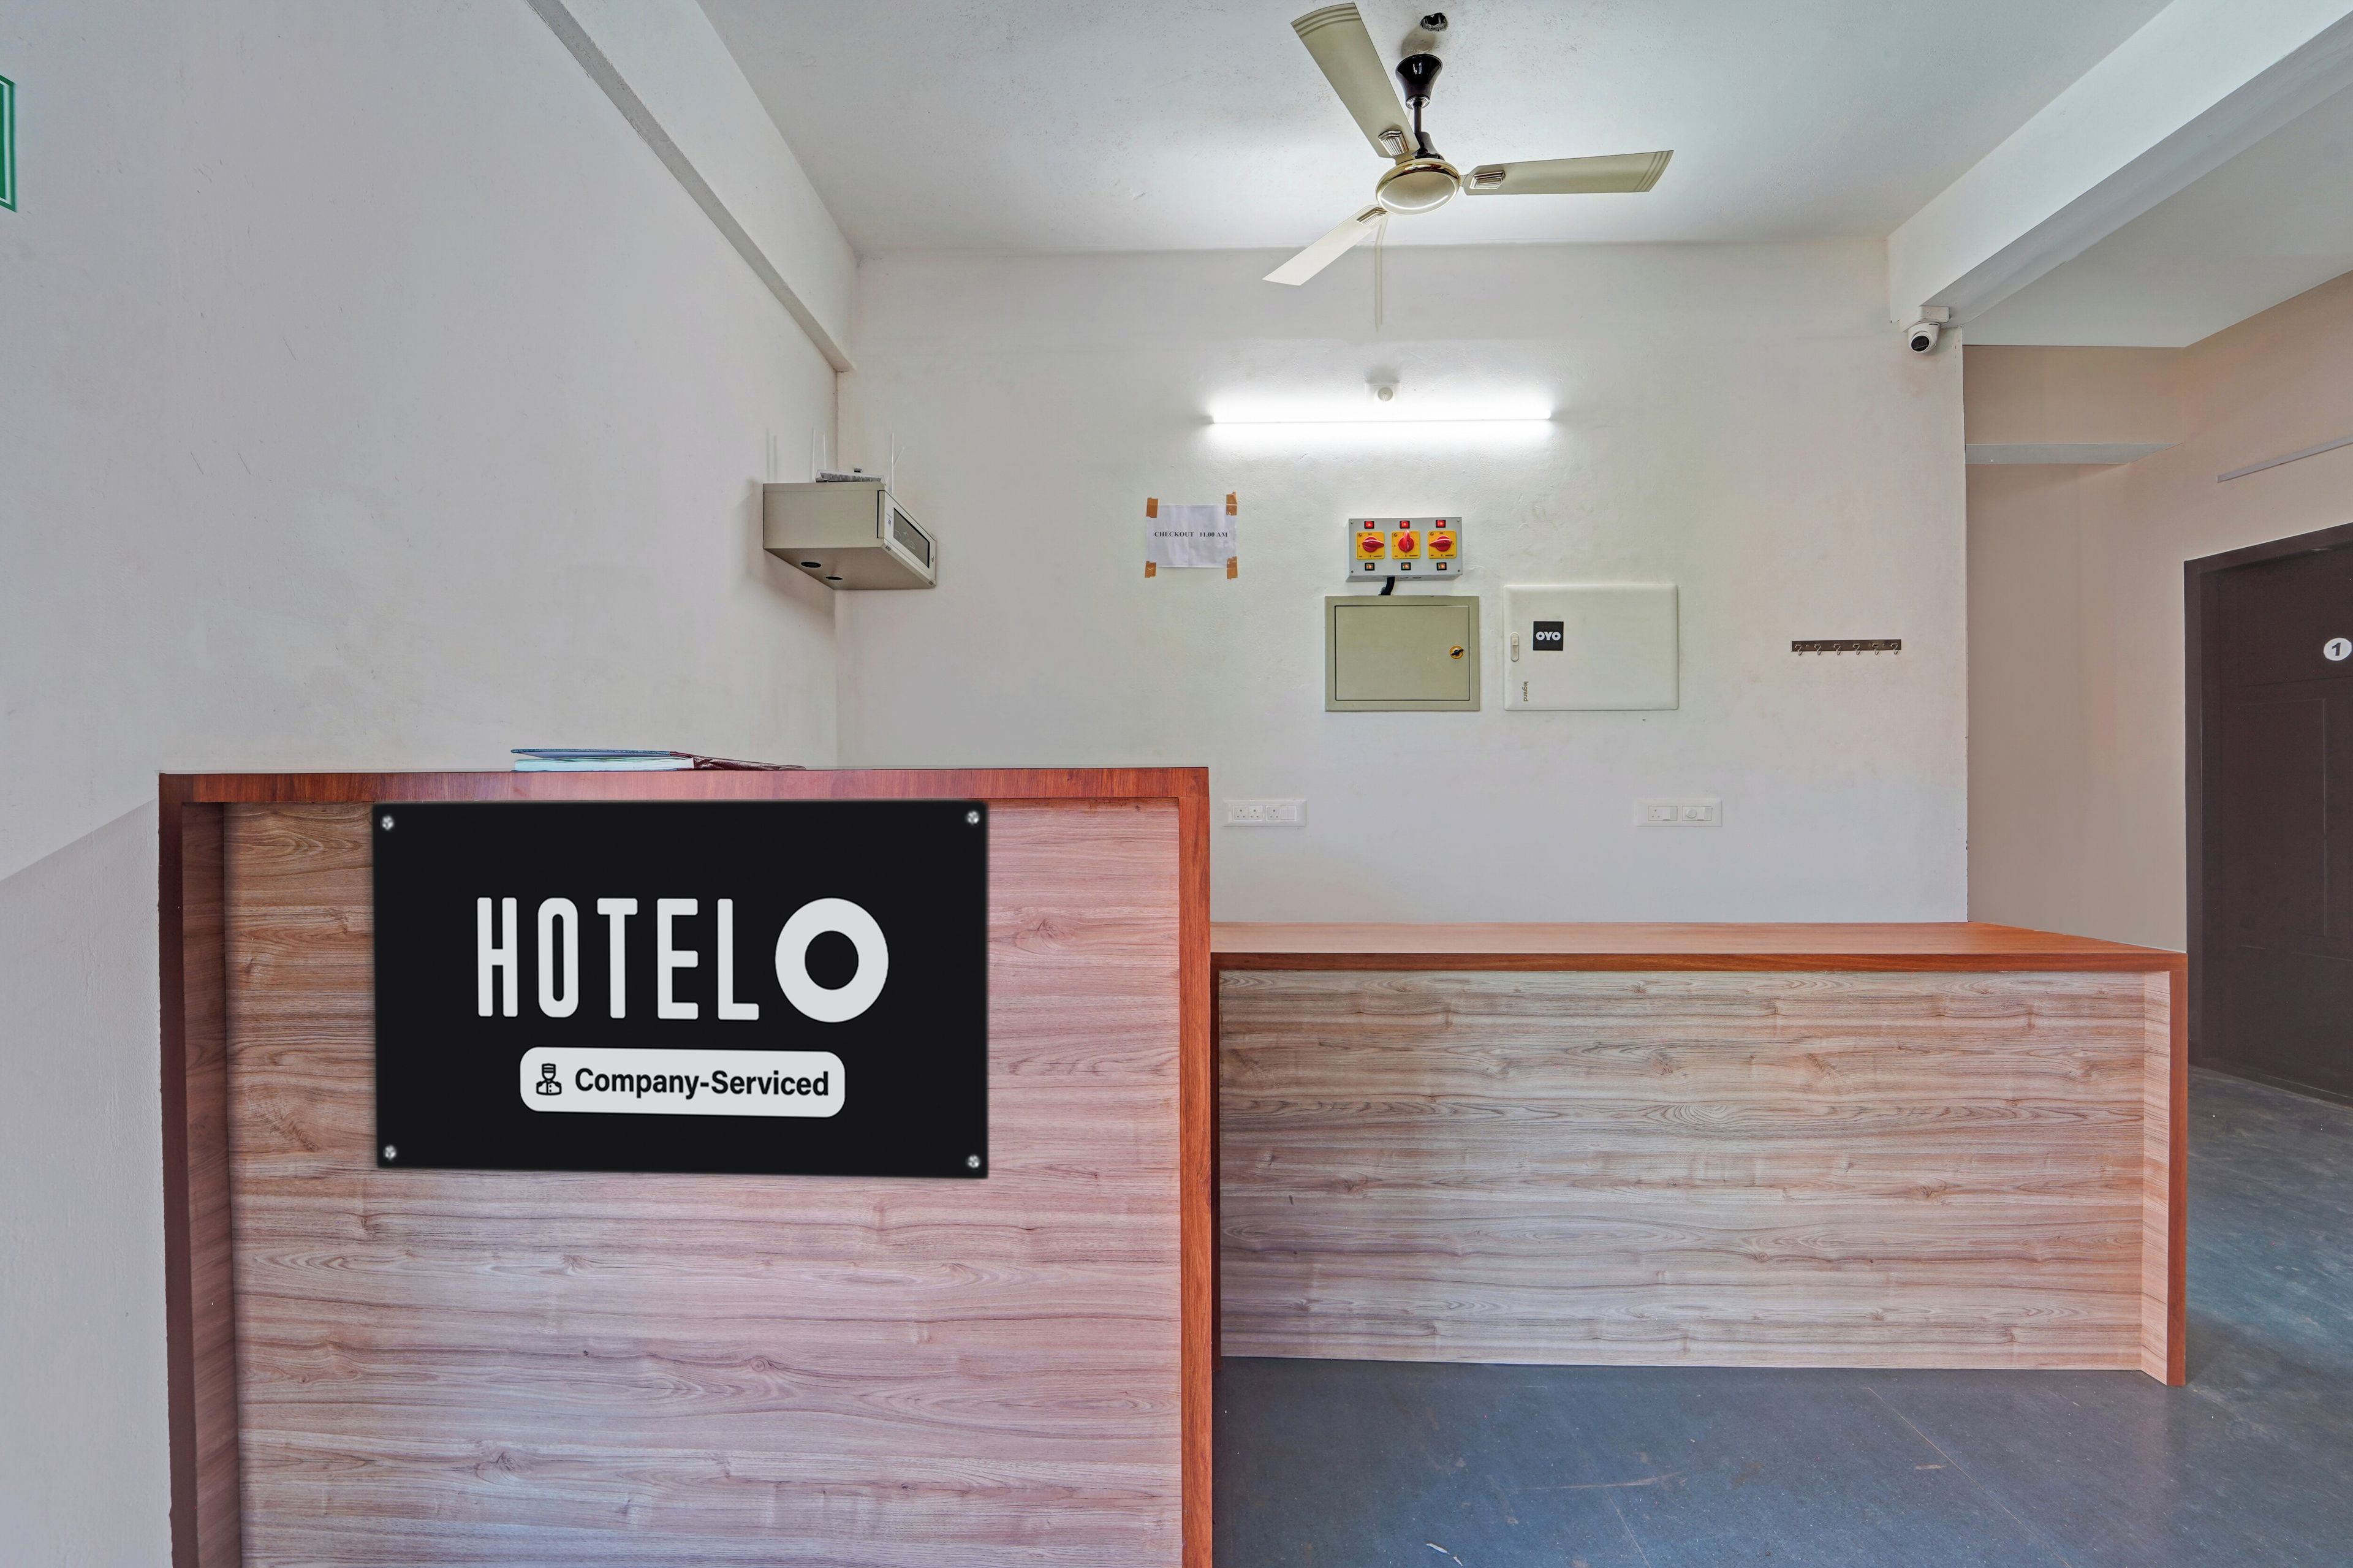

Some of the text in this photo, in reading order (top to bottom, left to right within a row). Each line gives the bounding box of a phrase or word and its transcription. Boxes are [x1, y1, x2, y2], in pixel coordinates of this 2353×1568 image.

[1536, 631, 1561, 641] OYO
[2331, 642, 2341, 656] 1
[575, 1067, 829, 1100] Company-Serviced
